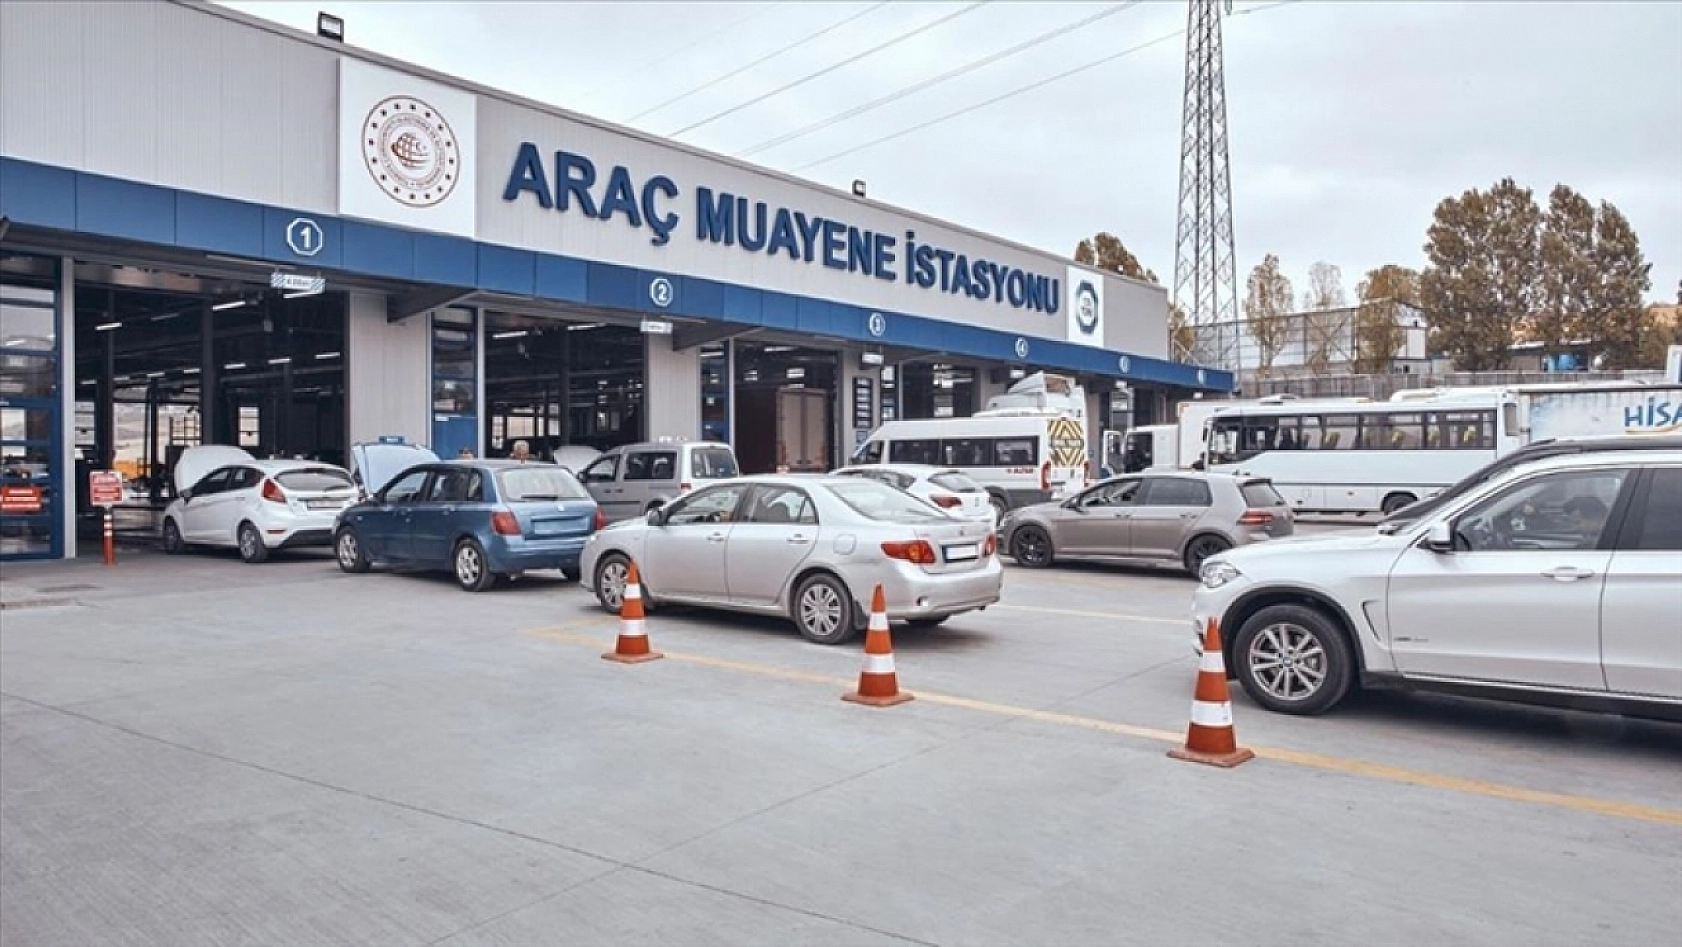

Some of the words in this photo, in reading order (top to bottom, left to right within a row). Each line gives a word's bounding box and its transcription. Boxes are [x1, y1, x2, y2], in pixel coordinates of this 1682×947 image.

[300, 226, 311, 248] 1
[503, 142, 678, 246] ARAÇ
[696, 187, 896, 281] MUAYENE
[906, 231, 1059, 314] İSTASYONU
[658, 283, 667, 301] 2
